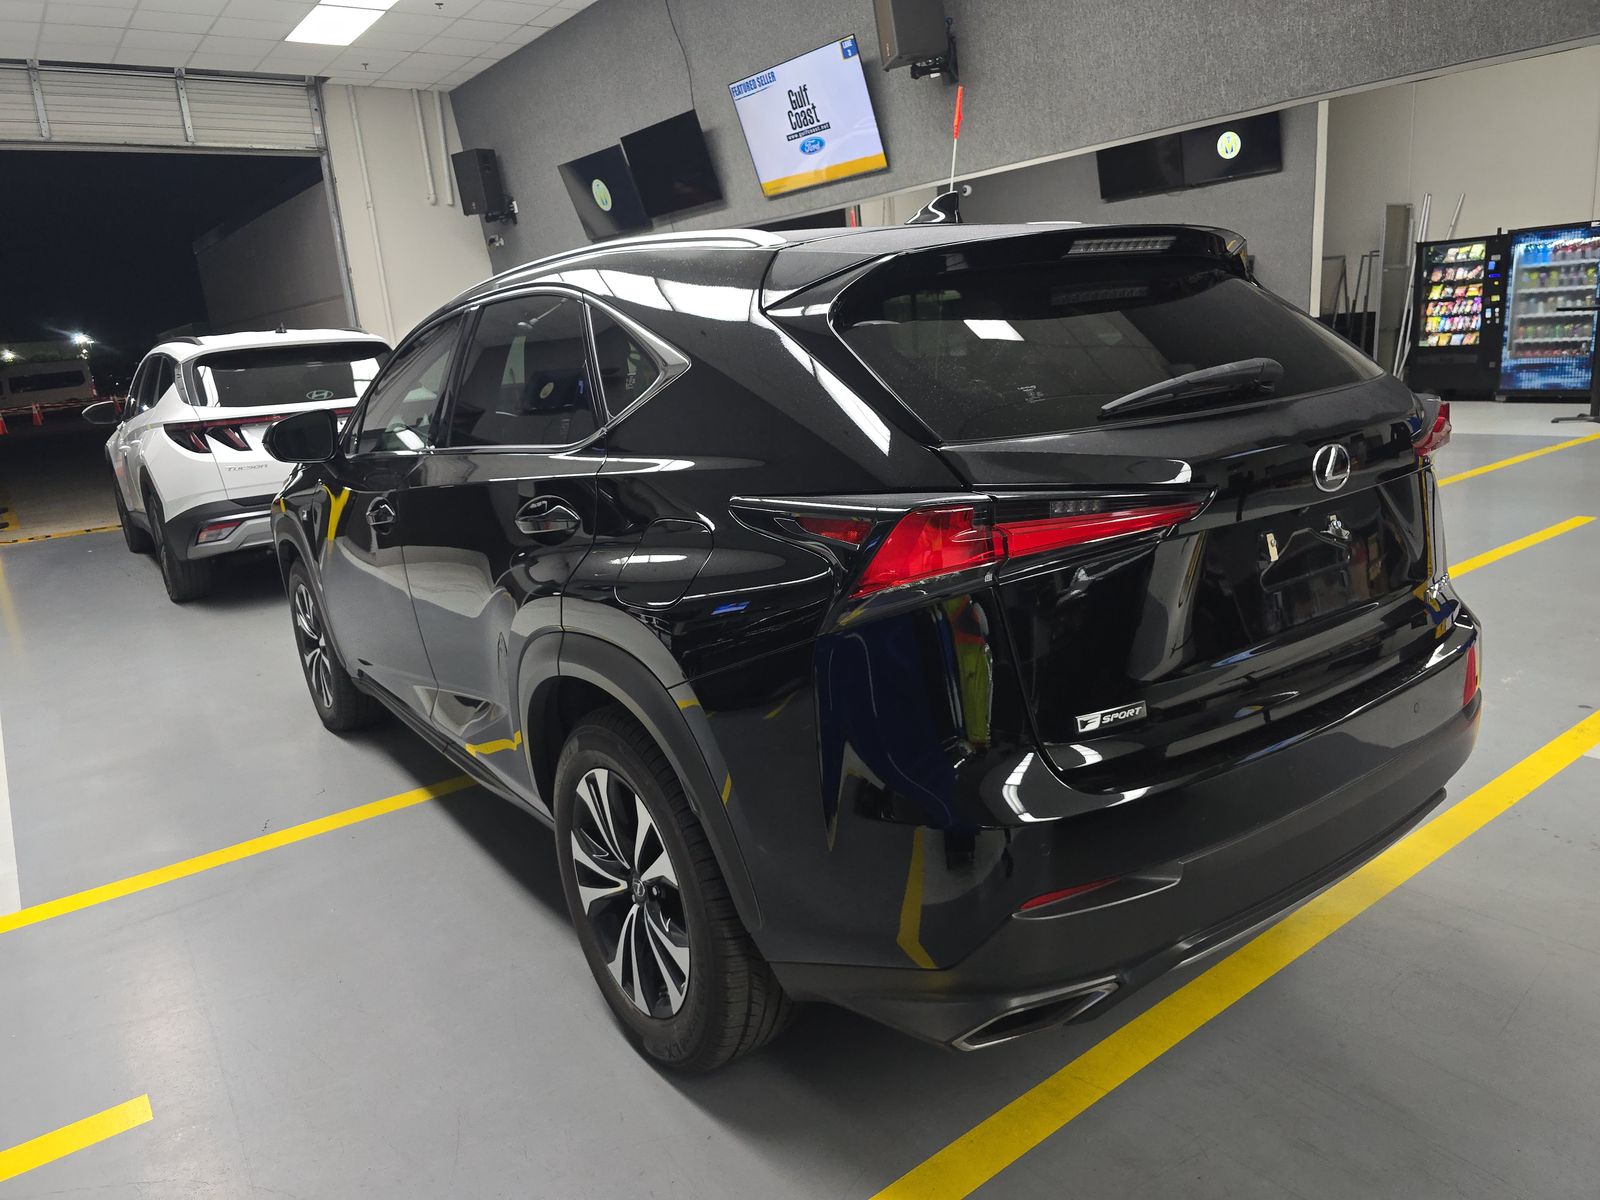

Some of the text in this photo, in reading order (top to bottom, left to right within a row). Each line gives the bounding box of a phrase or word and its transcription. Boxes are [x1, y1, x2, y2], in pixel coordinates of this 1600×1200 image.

[731, 71, 776, 97] FEATURED SELLER
[787, 84, 810, 110] Gulf
[787, 102, 820, 130] Coast
[1101, 706, 1142, 724] SPORT
